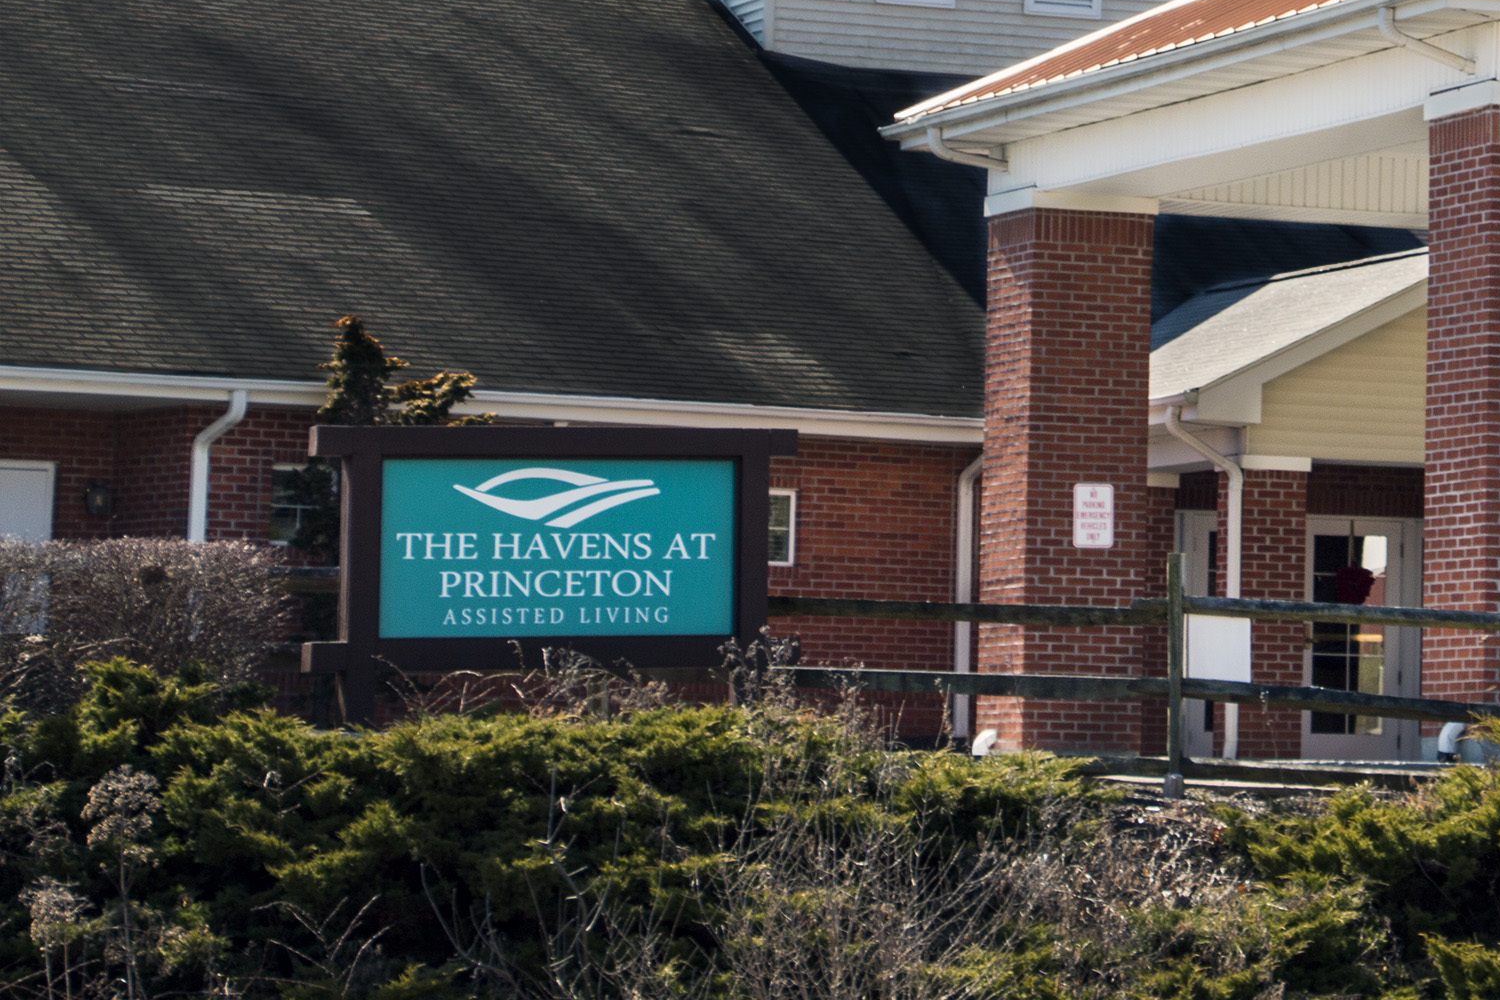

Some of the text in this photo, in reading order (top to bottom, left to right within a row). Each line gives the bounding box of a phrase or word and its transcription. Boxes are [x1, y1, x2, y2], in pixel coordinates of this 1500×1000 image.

[396, 532, 716, 560] THE HAVENS AT
[438, 569, 673, 598] PRINCETON
[442, 606, 669, 625] ASSISTED LIVING
